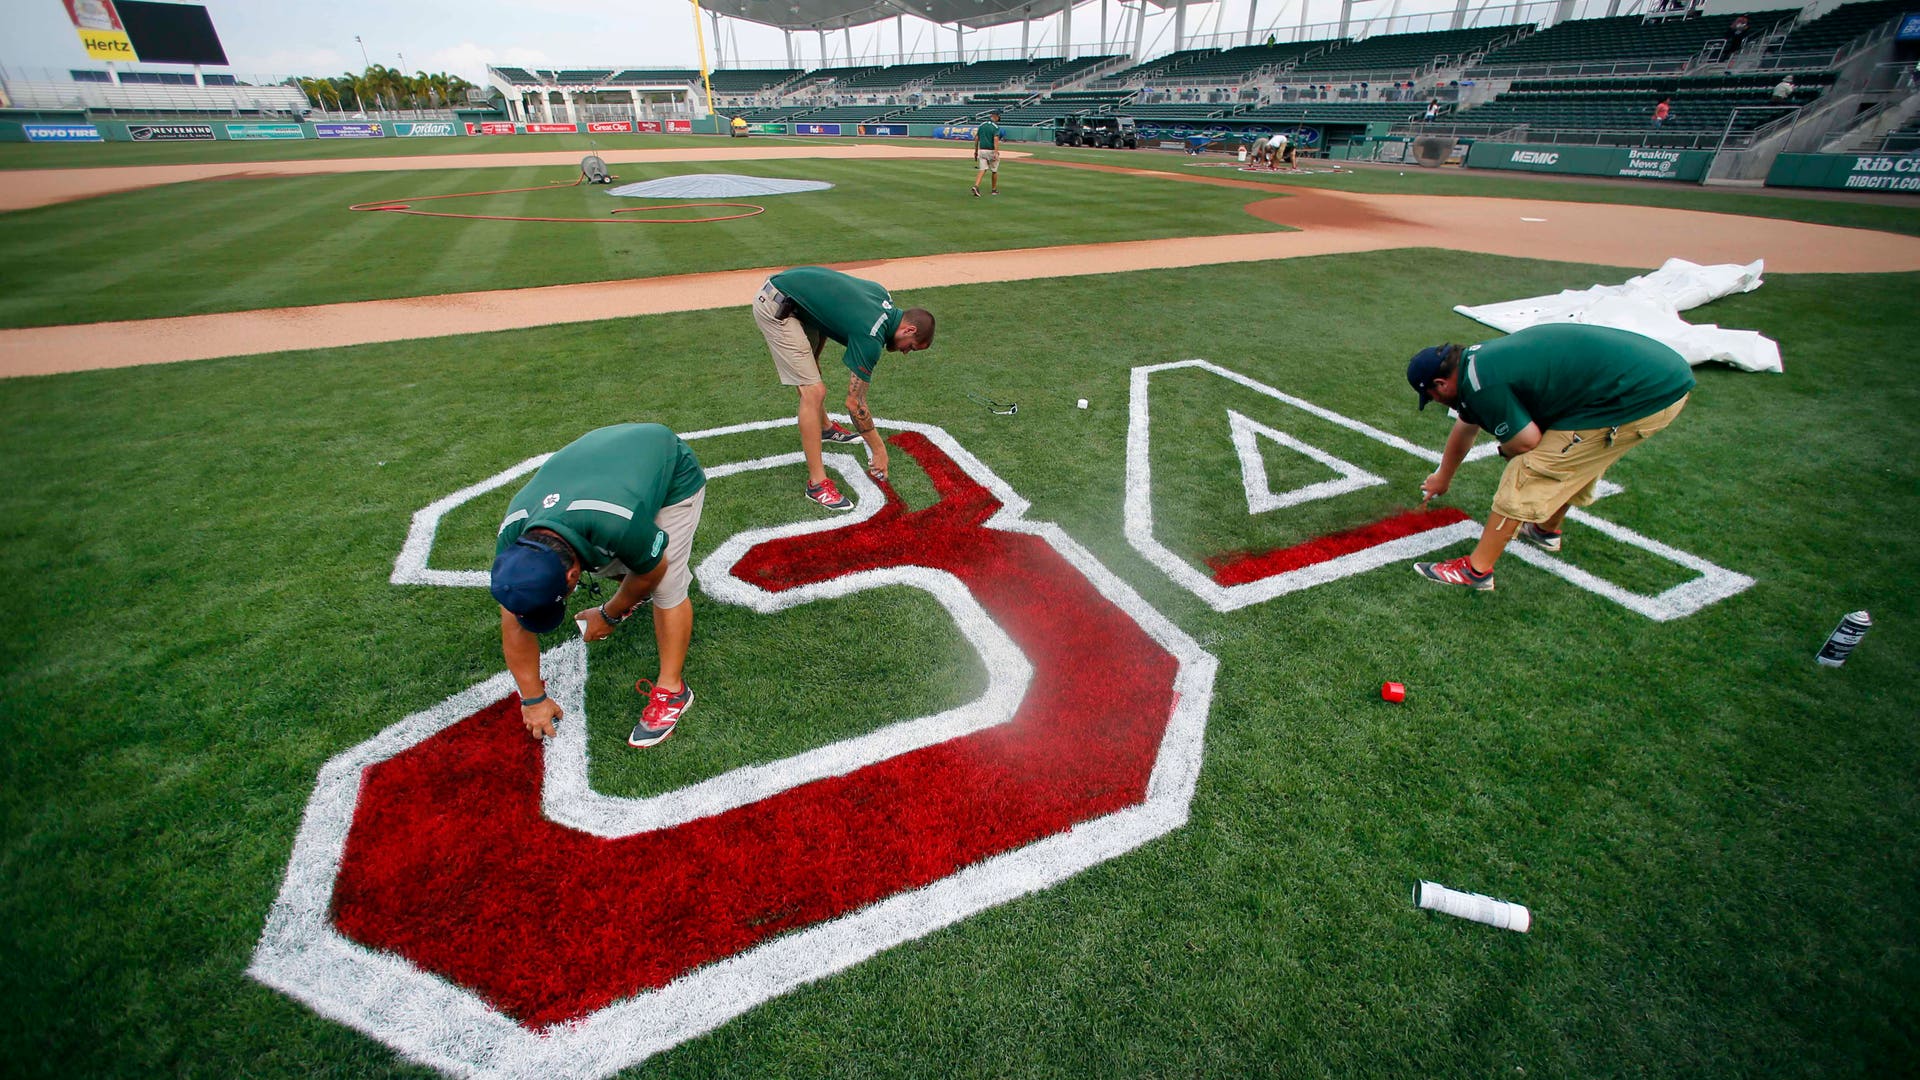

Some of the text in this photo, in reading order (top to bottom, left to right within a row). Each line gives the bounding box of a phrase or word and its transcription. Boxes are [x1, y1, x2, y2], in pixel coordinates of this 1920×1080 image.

[84, 38, 130, 52] Hertz
[1510, 150, 1559, 165] MEMIC
[1628, 150, 1680, 162] Breaking
[1629, 159, 1659, 169] News
[1852, 157, 1894, 172] Rib
[1845, 175, 1920, 190] RIBCITY.CO
